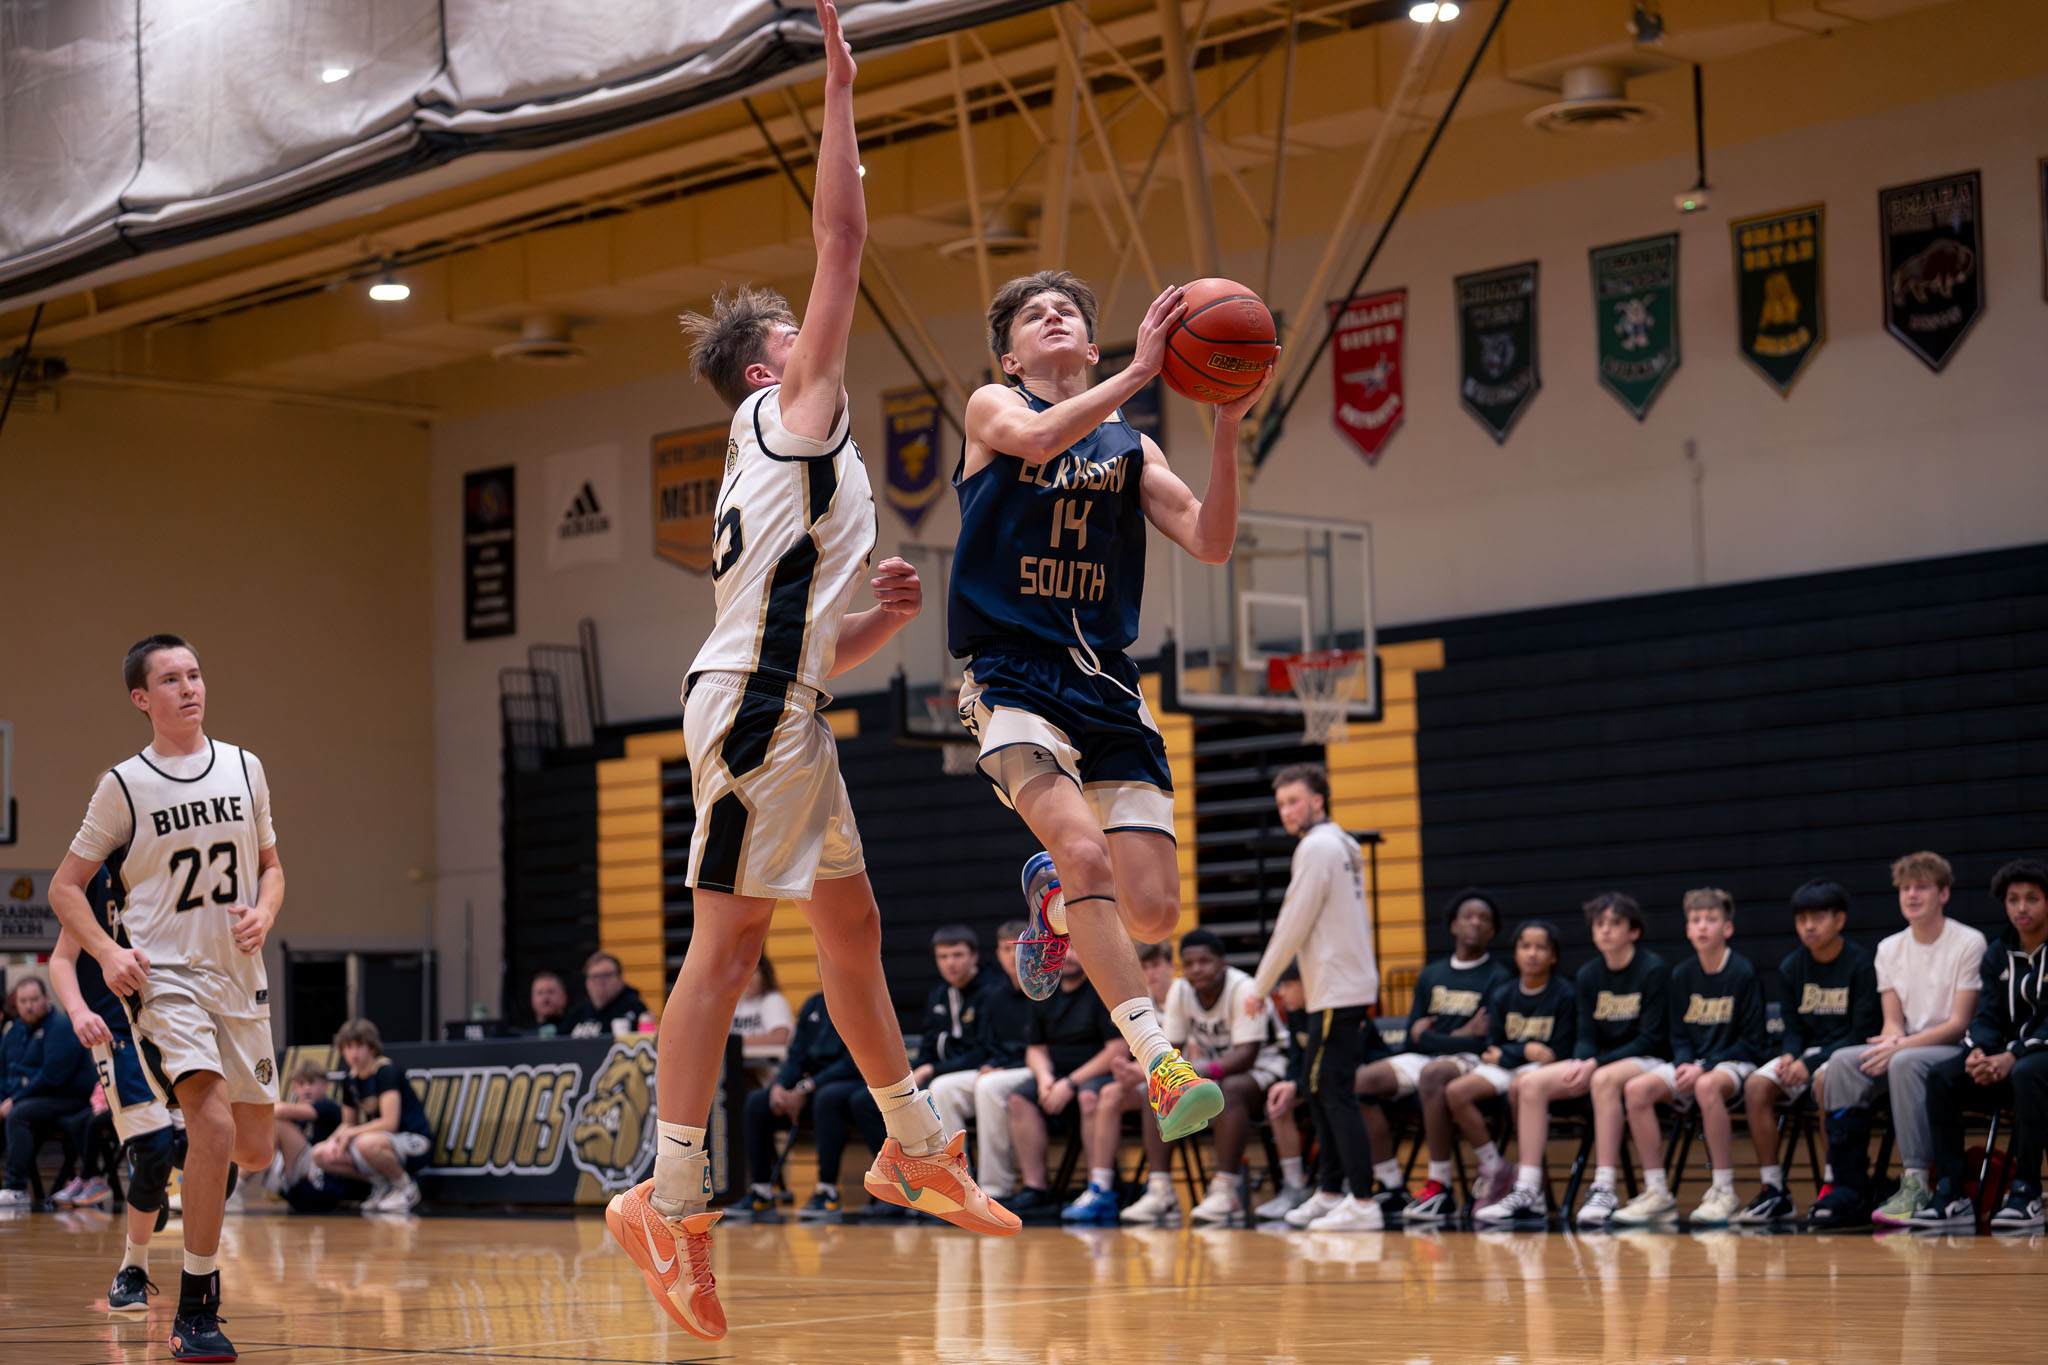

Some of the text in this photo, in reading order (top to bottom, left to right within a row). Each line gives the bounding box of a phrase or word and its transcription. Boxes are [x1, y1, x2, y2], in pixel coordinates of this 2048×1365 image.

[1741, 218, 1814, 249] OMAHA
[1018, 456, 1128, 493] ELKHORN
[661, 478, 718, 521] METR
[1050, 498, 1093, 550] 14
[1020, 556, 1105, 601] SOUTH
[151, 797, 244, 837] BURKE
[169, 842, 238, 913] 23
[405, 1063, 581, 1176] ULLDOGS
